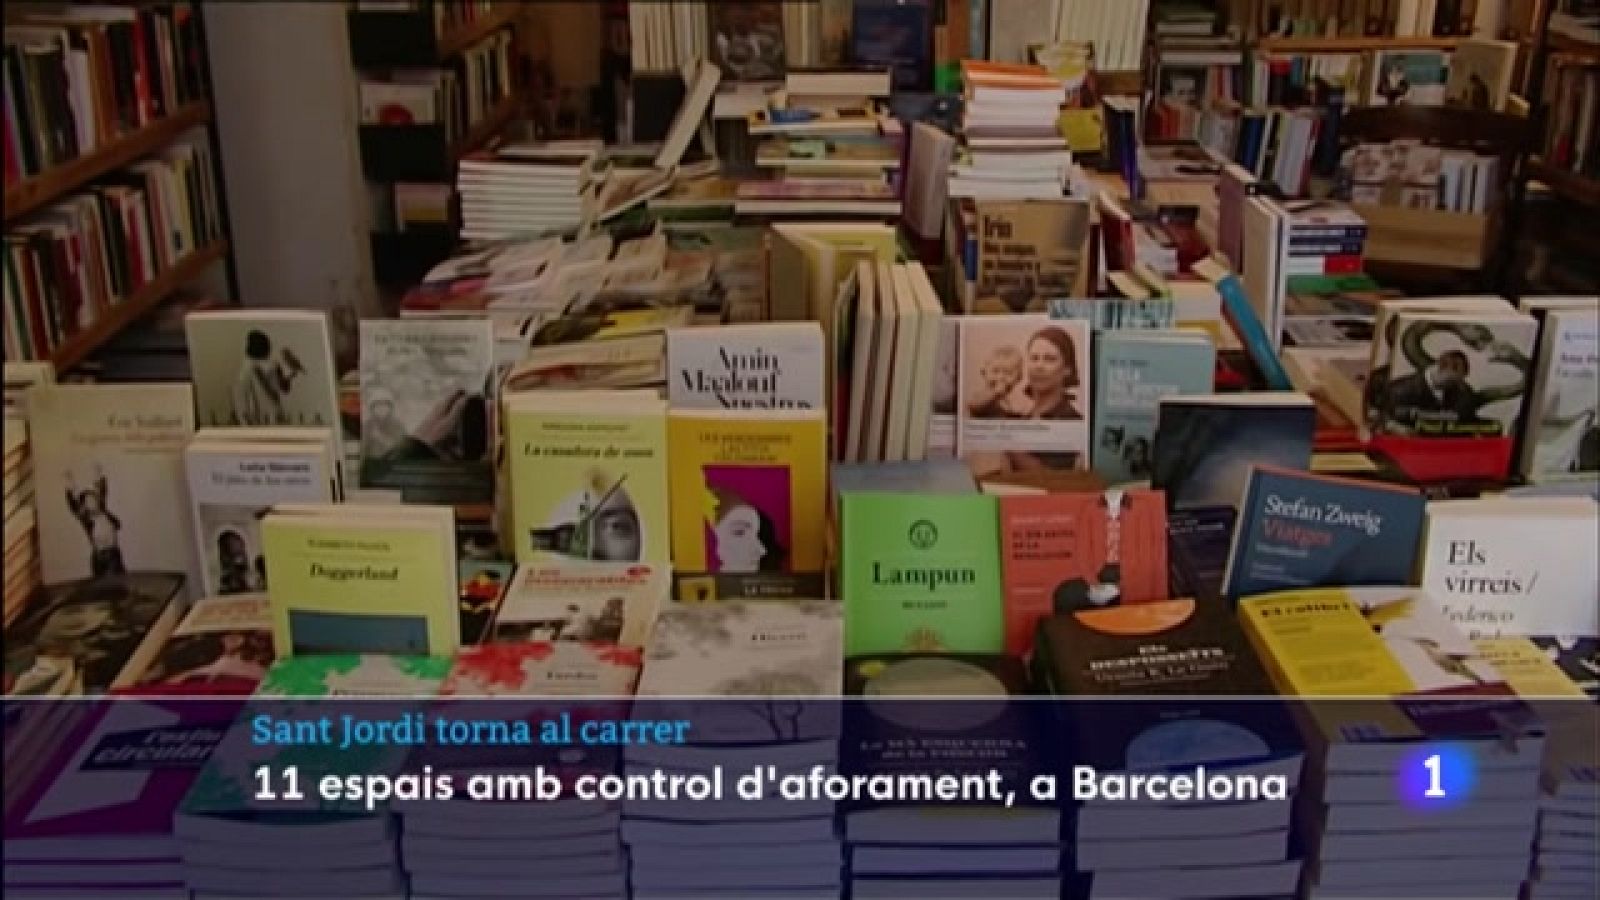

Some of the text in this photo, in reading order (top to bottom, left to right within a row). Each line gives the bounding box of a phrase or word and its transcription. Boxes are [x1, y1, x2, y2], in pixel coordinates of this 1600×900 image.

[719, 345, 782, 376] Amin
[681, 369, 776, 393] Maalouf
[1264, 494, 1382, 537] Stefan Zweig
[1448, 539, 1486, 565] Els
[872, 561, 976, 592] Lampun
